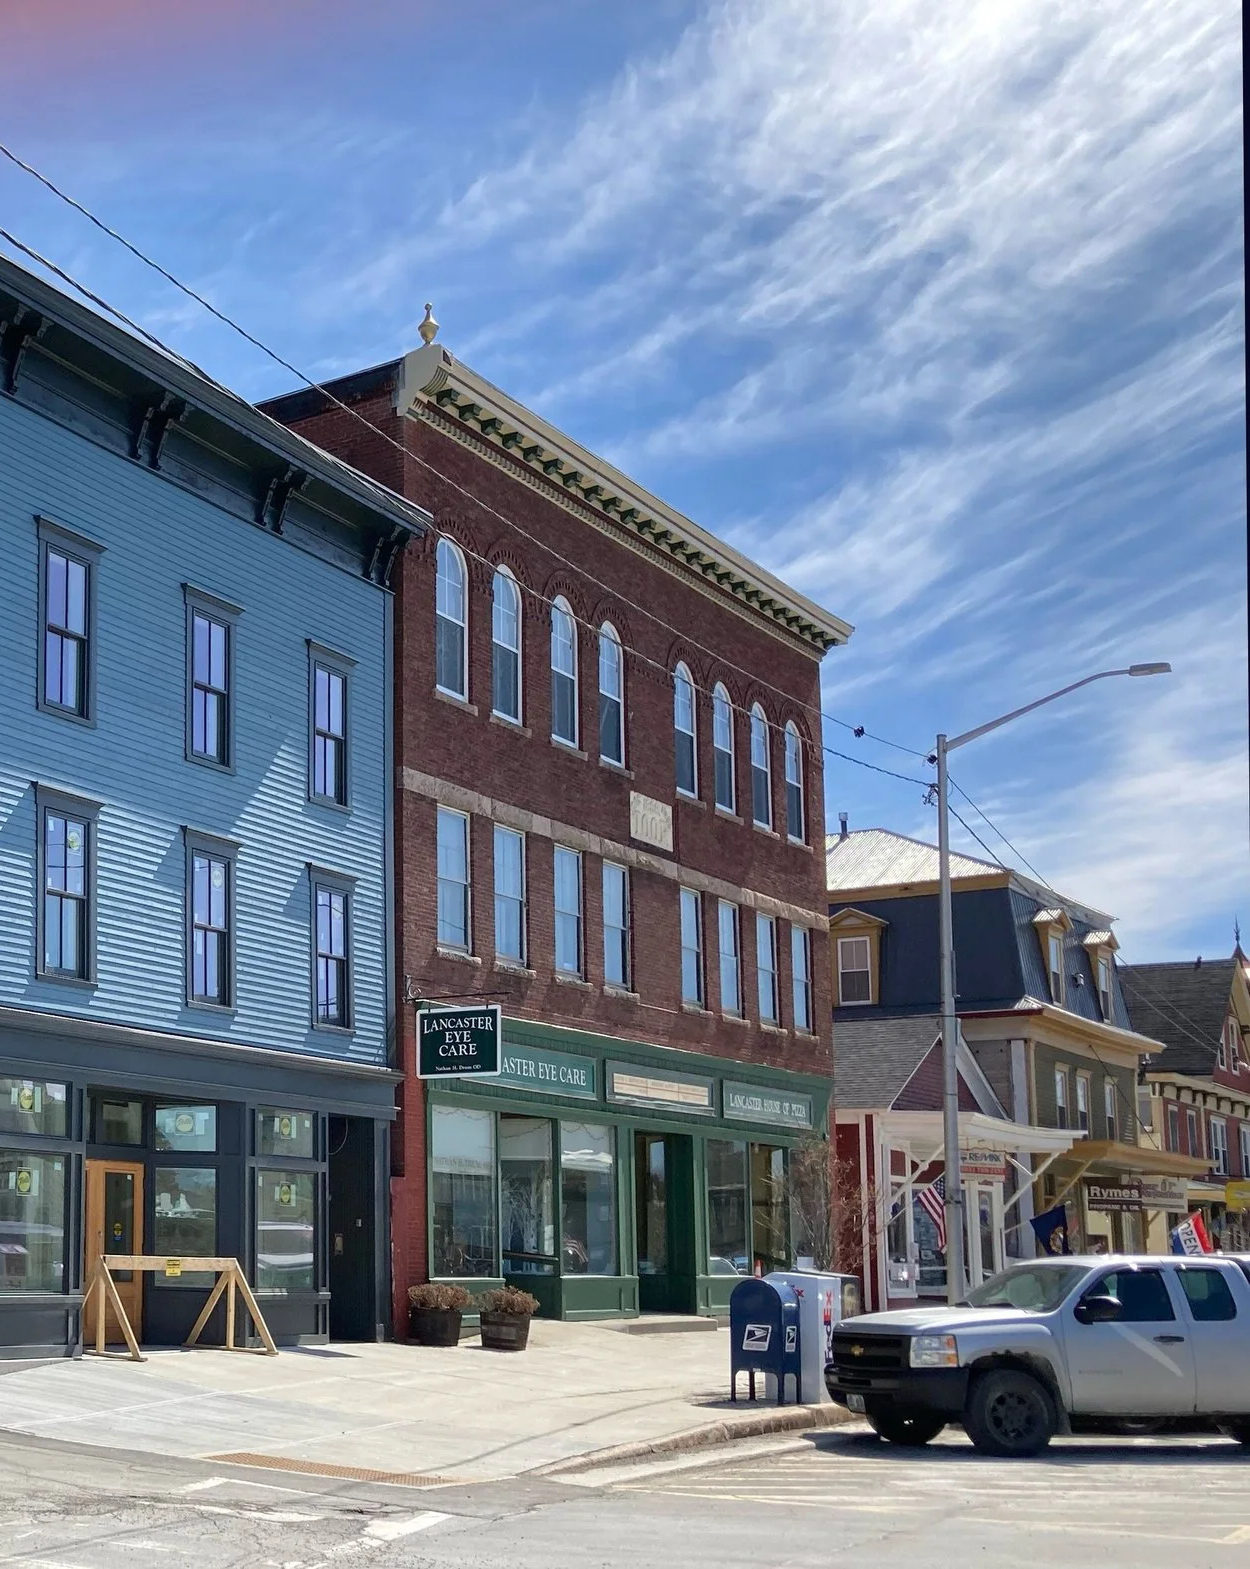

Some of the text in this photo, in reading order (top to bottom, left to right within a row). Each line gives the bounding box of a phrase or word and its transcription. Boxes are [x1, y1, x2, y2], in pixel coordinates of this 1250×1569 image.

[423, 1016, 493, 1034] LANCASTER
[445, 1030, 471, 1043] EYE
[439, 1043, 478, 1057] CARE
[502, 1057, 586, 1086] ASTER EYE CARE
[729, 1093, 806, 1117] LANCASTER HOUSE OF PIZZA
[1090, 1185, 1140, 1199] Rymes
